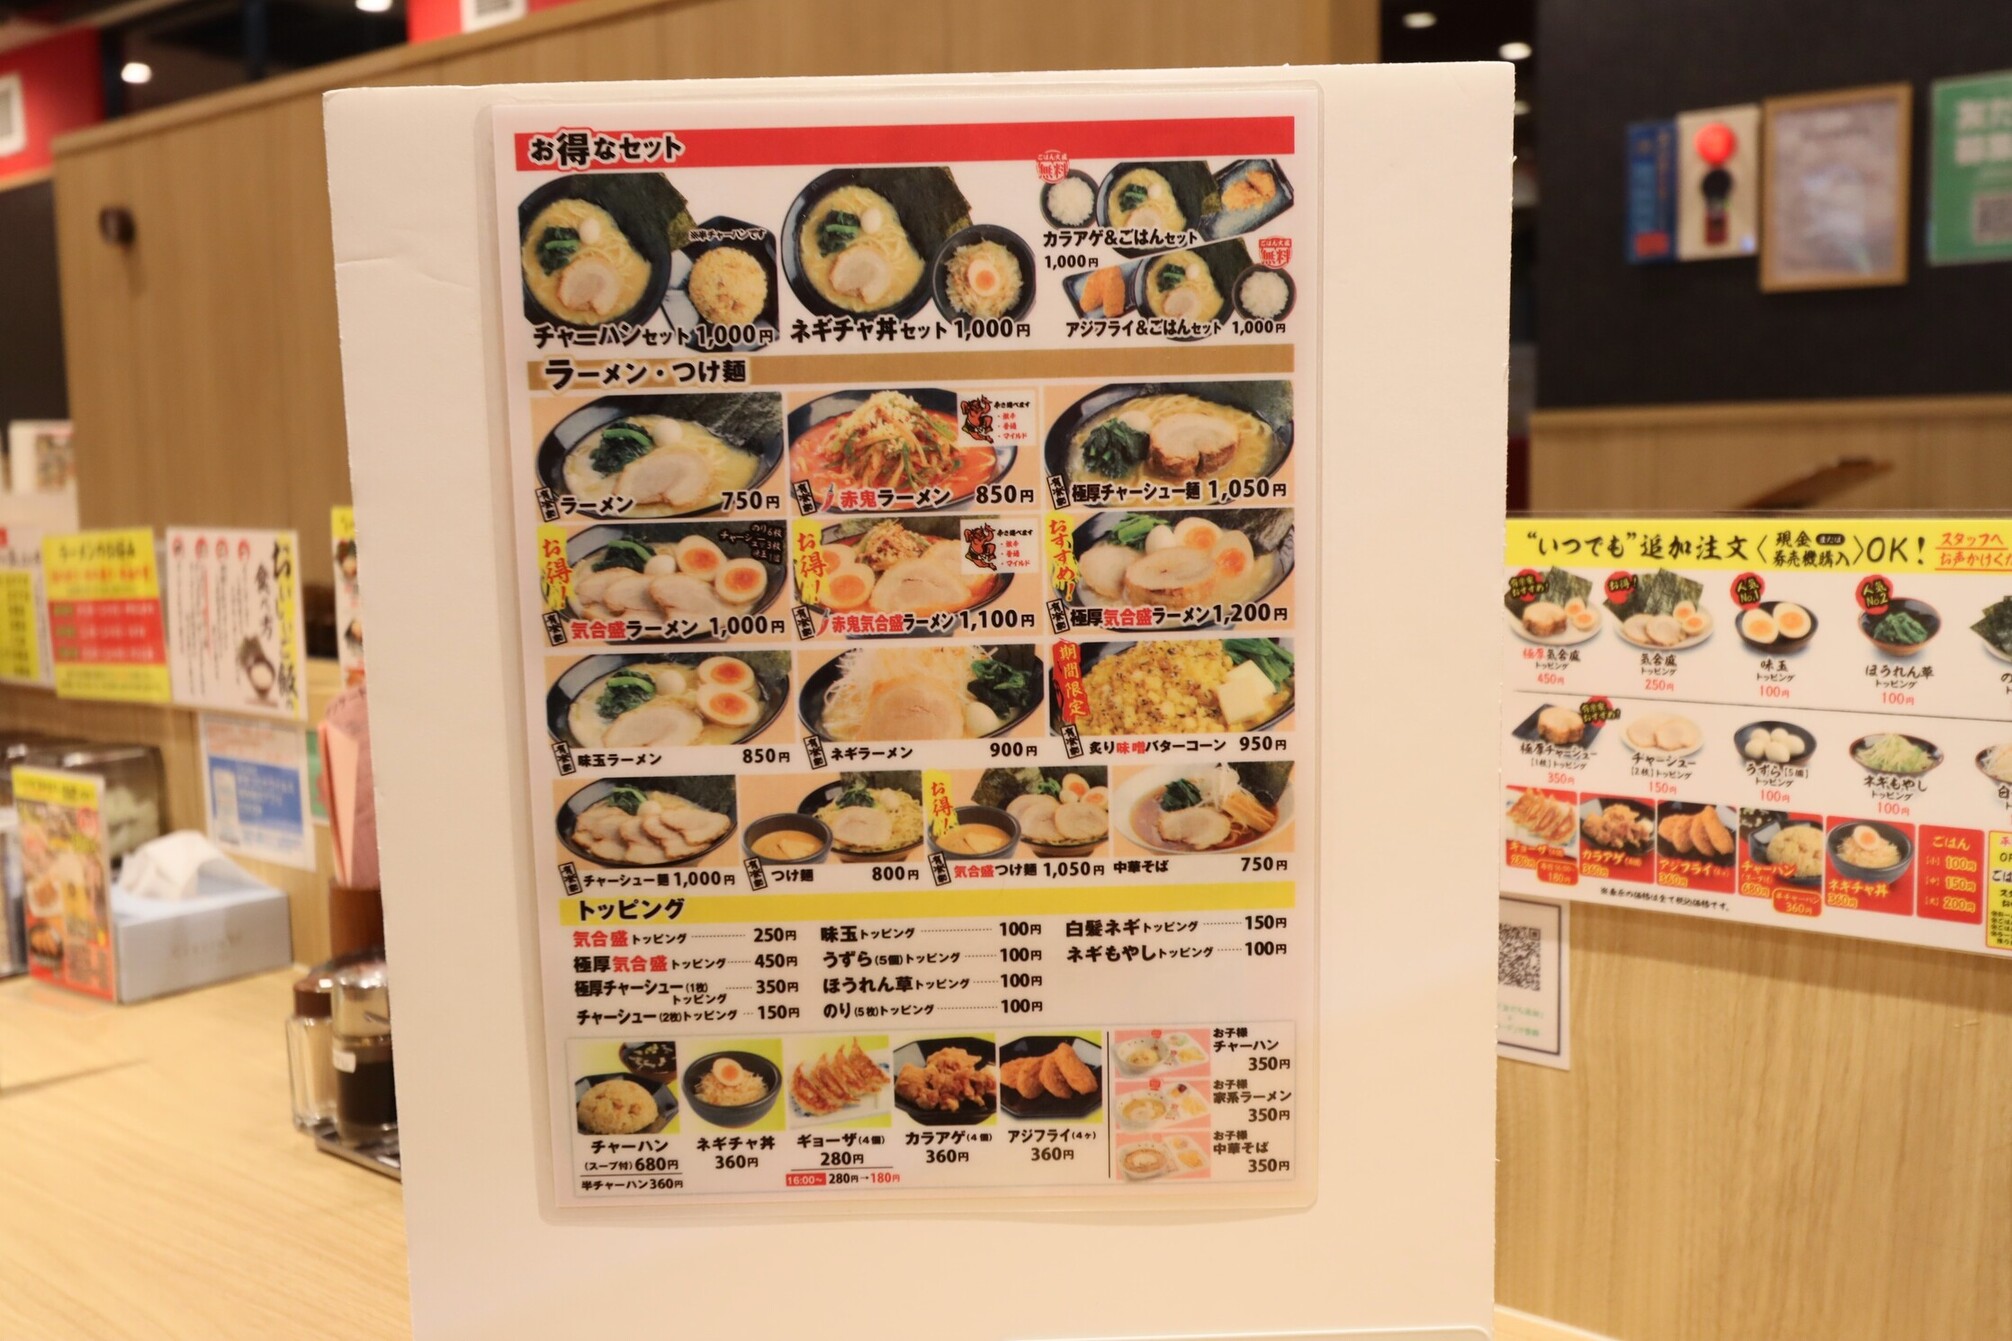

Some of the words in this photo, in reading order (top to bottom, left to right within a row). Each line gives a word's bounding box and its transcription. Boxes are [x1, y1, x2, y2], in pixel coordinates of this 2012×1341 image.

[531, 131, 682, 167] お得なセット
[1038, 163, 1068, 180] 無料
[1044, 255, 1099, 270] 1,000円
[1260, 248, 1291, 265] 無料
[791, 319, 947, 343] ネギチャ丼セット
[955, 319, 1031, 339] 1,000円
[1232, 320, 1286, 335] 1,000円
[546, 359, 746, 390] ラーメン・つけ麺
[840, 488, 950, 508] 赤鬼ラーメン
[976, 486, 1034, 503] 850円
[1072, 482, 1201, 501] 極厚チャーシュー麺
[1208, 479, 1287, 501] 1,050円
[560, 497, 633, 514] ラーメン
[721, 491, 780, 511] 750円
[1776, 531, 1811, 547] 現金
[1942, 532, 2004, 546] スタッフへ
[1772, 550, 1850, 568] 券売機購入
[1863, 579, 1887, 595] 人気
[832, 612, 955, 634] 赤鬼気合盛ラーメン
[959, 609, 1035, 631] 1,100円
[1070, 607, 1210, 627] 極厚気合盛ラーメン
[1213, 603, 1288, 625] 1,200円
[570, 620, 698, 640] 気合盛ラーメン
[709, 616, 785, 638] 1,000円
[1640, 653, 1678, 668] 気合盛
[1760, 659, 1789, 674] 味玉
[1537, 673, 1565, 686] 450円
[1865, 664, 1935, 680] ほうれん草
[1059, 643, 1086, 717] 期間限定
[1645, 679, 1675, 691] 250円
[1759, 685, 1790, 698] 100円
[1881, 692, 1915, 706] 100円
[831, 746, 913, 760] ネギラーメン
[990, 742, 1037, 757] 900円
[1089, 740, 1226, 755] 炙り味噌バターコーン
[1239, 736, 1287, 751] 950円
[577, 753, 662, 767] 味玉ラーメン
[742, 748, 790, 763] 850円
[1631, 752, 1697, 769] チャーシュー
[1547, 772, 1575, 785] 350円
[1863, 775, 1928, 793] ネギもやし
[1649, 781, 1677, 795] 150円
[1760, 790, 1790, 803] 100円
[1877, 801, 1910, 816] 100円
[1933, 836, 1970, 851] ごはん
[954, 863, 1038, 878] 気合盛つけ麺
[1043, 861, 1105, 879] 1,050円
[1113, 859, 1169, 873] 中華そば
[1240, 857, 1288, 871] 750円
[1945, 855, 1977, 872] 100円
[583, 873, 670, 887] チャーシュー麺
[673, 870, 736, 888] 1,000円
[771, 868, 814, 882] つけ麺
[872, 867, 919, 881] 800円
[1945, 876, 1976, 893] 150円
[579, 898, 685, 921] トッピング
[1943, 896, 1976, 914] 200円
[821, 926, 915, 943] 味玉トッピング
[1000, 922, 1042, 936] 100円
[1066, 918, 1199, 937] 白髪ネギトッピング
[1245, 915, 1287, 930] 150円
[573, 930, 687, 947] 気合盛トッピング
[754, 928, 797, 942] 250円
[1000, 948, 1042, 962] 100円
[1067, 945, 1213, 963] ネギもやしトッピング
[1245, 942, 1287, 957] 100円
[573, 956, 726, 973] 極厚気合盛トッピング
[755, 953, 798, 968] 450円
[756, 979, 799, 994] 350円
[823, 976, 970, 993] ほうれん草トッピング
[1001, 973, 1042, 987] 100円
[672, 993, 727, 1005] トッピング
[1001, 998, 1043, 1013] 100円
[758, 1004, 800, 1019] 150円
[1213, 1028, 1248, 1038] お子様
[1213, 1039, 1279, 1053] チャーハン
[1248, 1056, 1291, 1071] 350円
[1213, 1079, 1248, 1090] お子様
[1213, 1090, 1292, 1104] 家系ラーメン
[1248, 1108, 1291, 1122] 350円
[1213, 1130, 1248, 1141] お子様
[591, 1140, 669, 1154] チャーハン
[697, 1137, 775, 1152] ネギチャ丼
[1213, 1141, 1270, 1155] 中華そば
[820, 1152, 864, 1166] 280円
[926, 1149, 969, 1163] 360円
[1031, 1147, 1075, 1161] 360円
[635, 1157, 679, 1172] 680円
[715, 1155, 759, 1170] 360円
[1248, 1158, 1291, 1173] 350円
